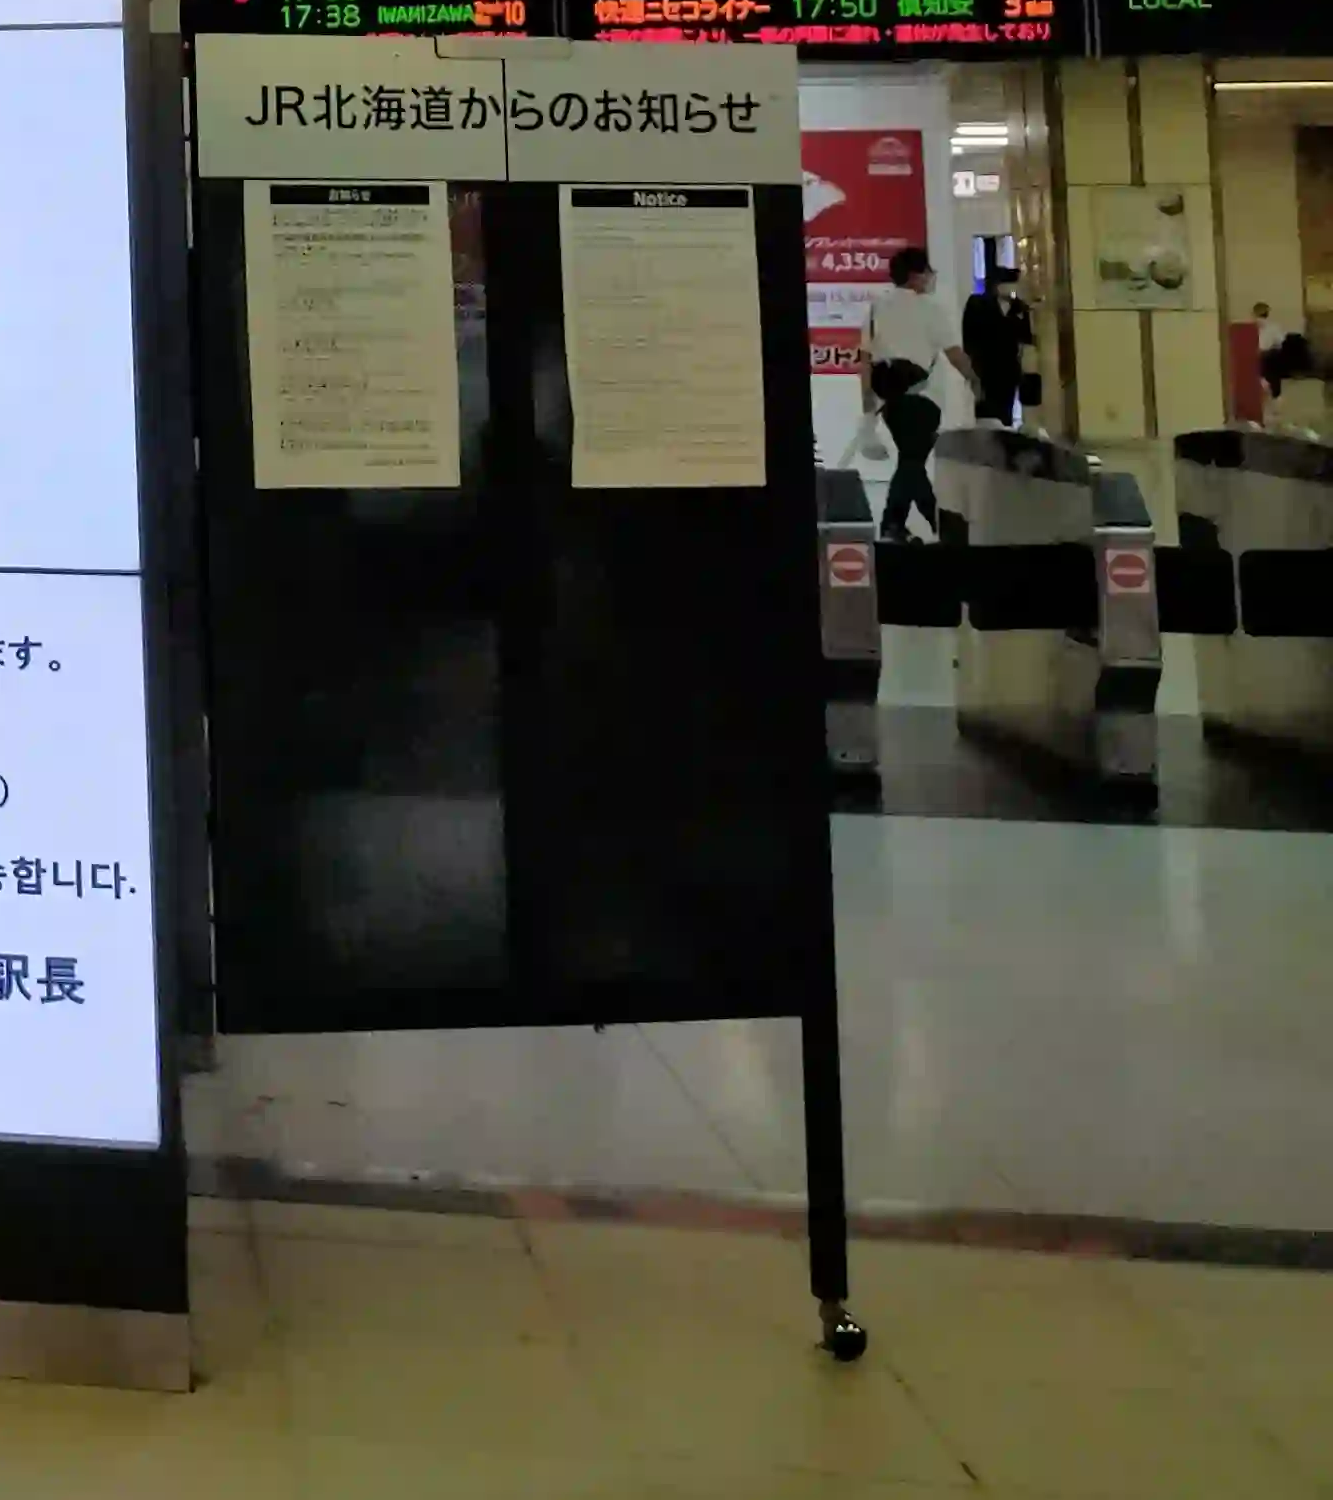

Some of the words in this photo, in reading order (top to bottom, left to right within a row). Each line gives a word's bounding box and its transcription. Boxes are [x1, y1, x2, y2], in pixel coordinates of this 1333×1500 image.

[280, 3, 361, 29] 17:38
[244, 85, 760, 135] JR北海道からのお知らせ
[632, 191, 688, 208] Notice
